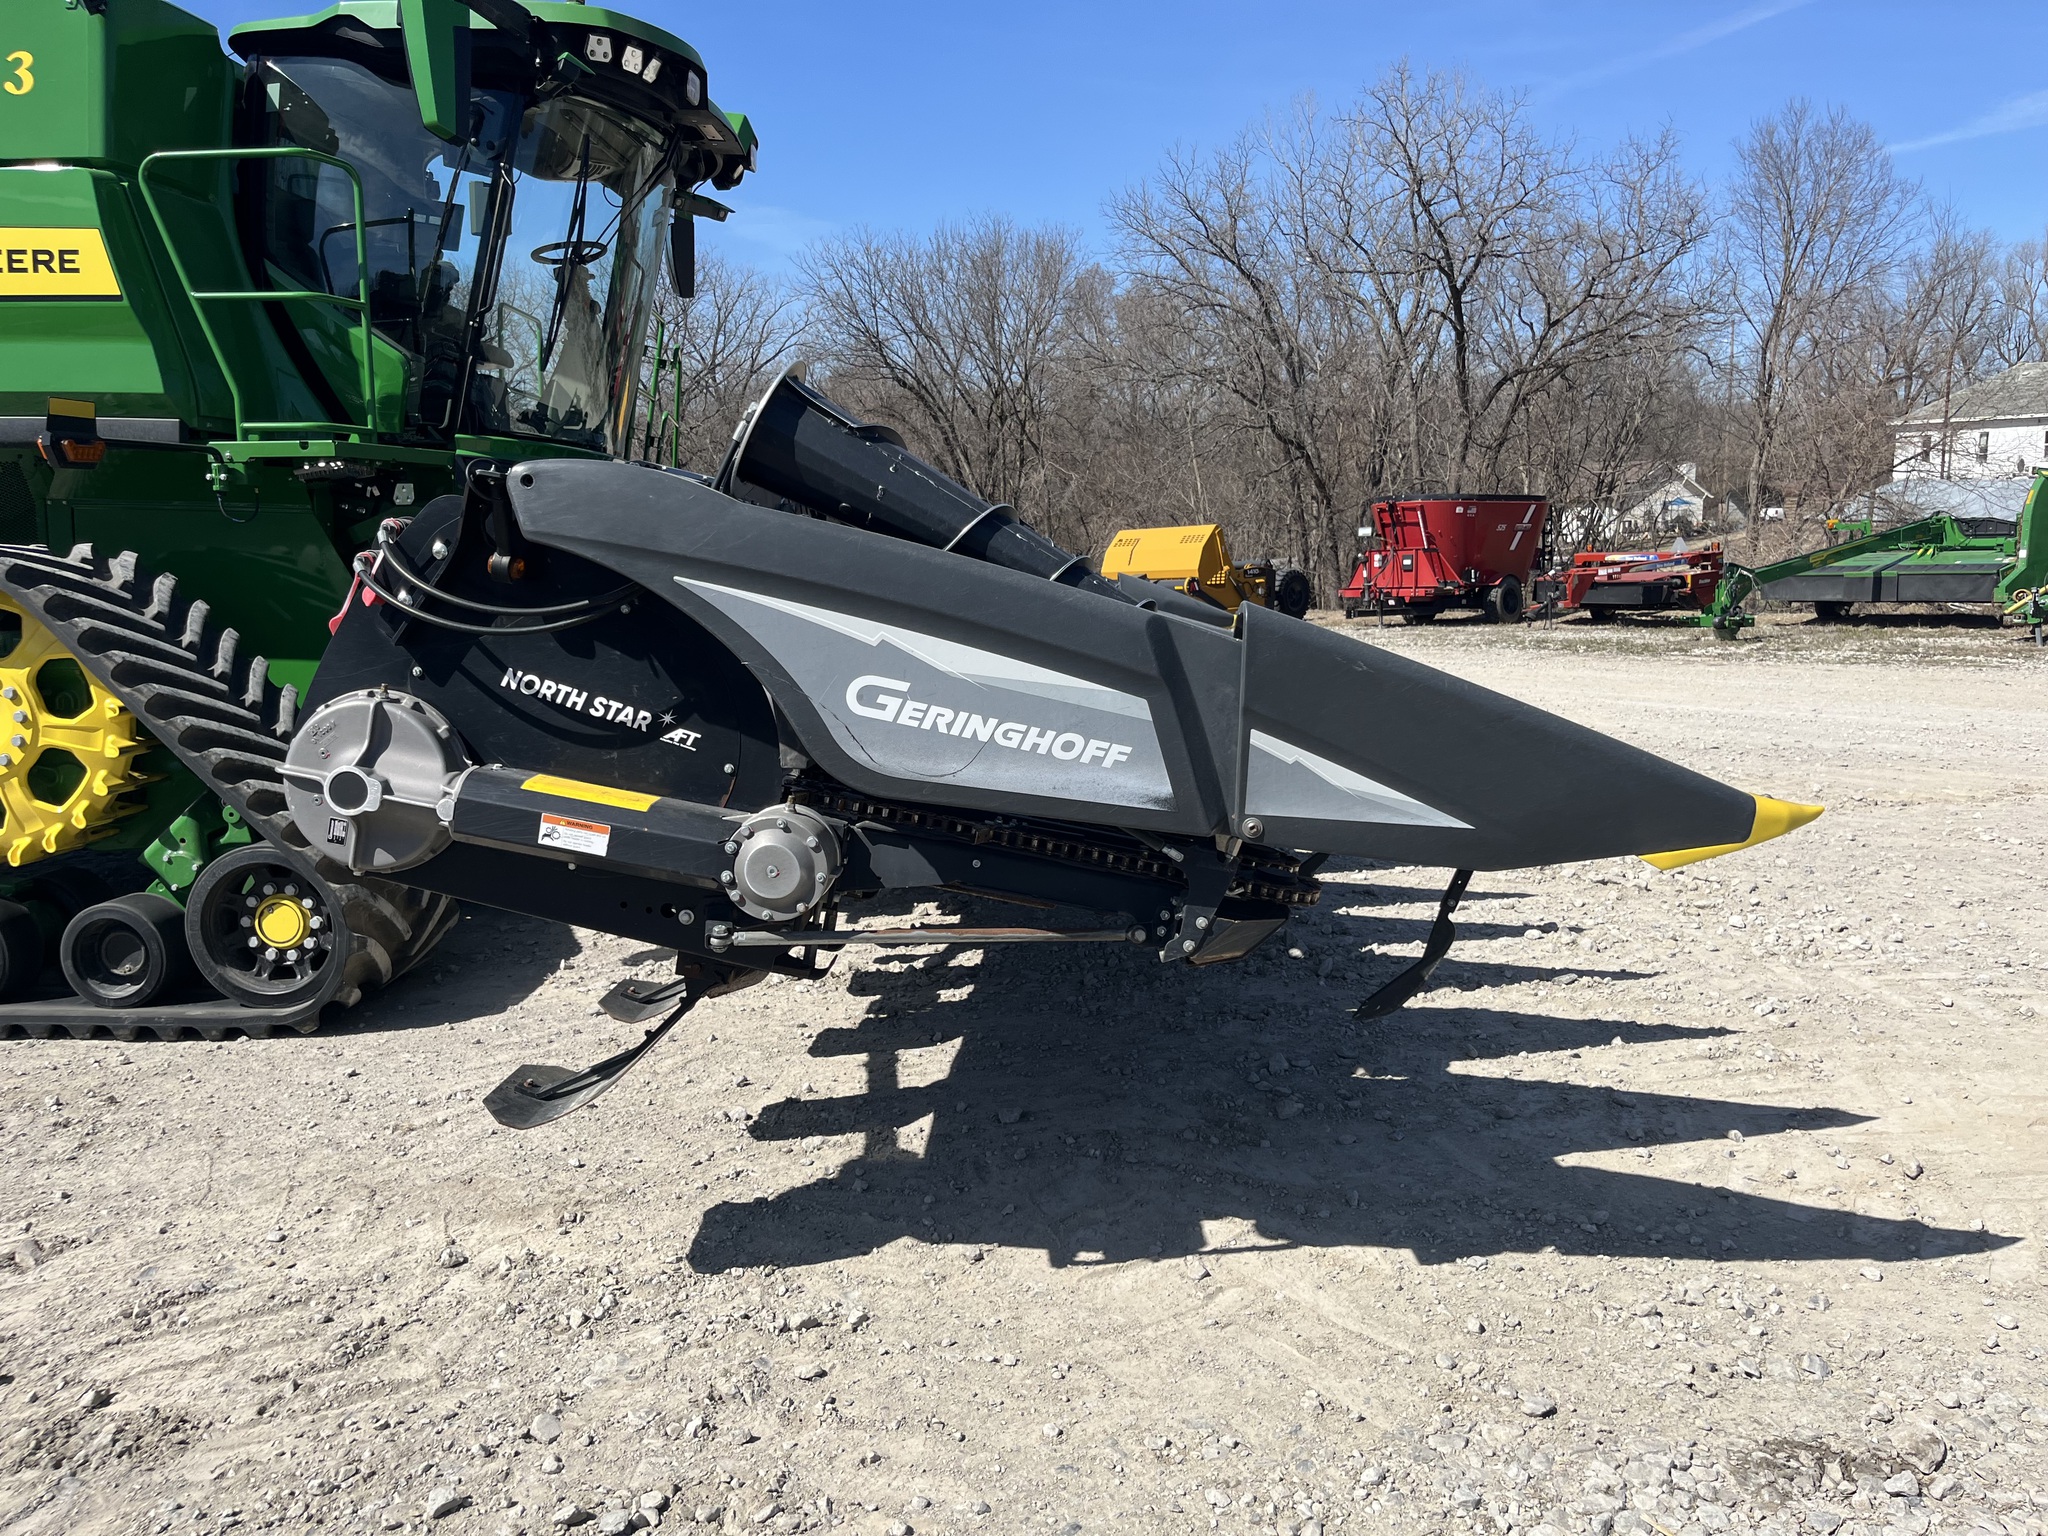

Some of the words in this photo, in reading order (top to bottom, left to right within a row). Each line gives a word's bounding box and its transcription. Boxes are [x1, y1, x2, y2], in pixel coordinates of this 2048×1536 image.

[3, 50, 35, 95] 3
[0, 249, 80, 274] ERE
[500, 667, 589, 712] NORTH
[589, 696, 653, 733] STAR
[662, 727, 702, 747] AFT
[845, 674, 1134, 769] GERINGHOFF
[566, 820, 594, 830] WARNING
